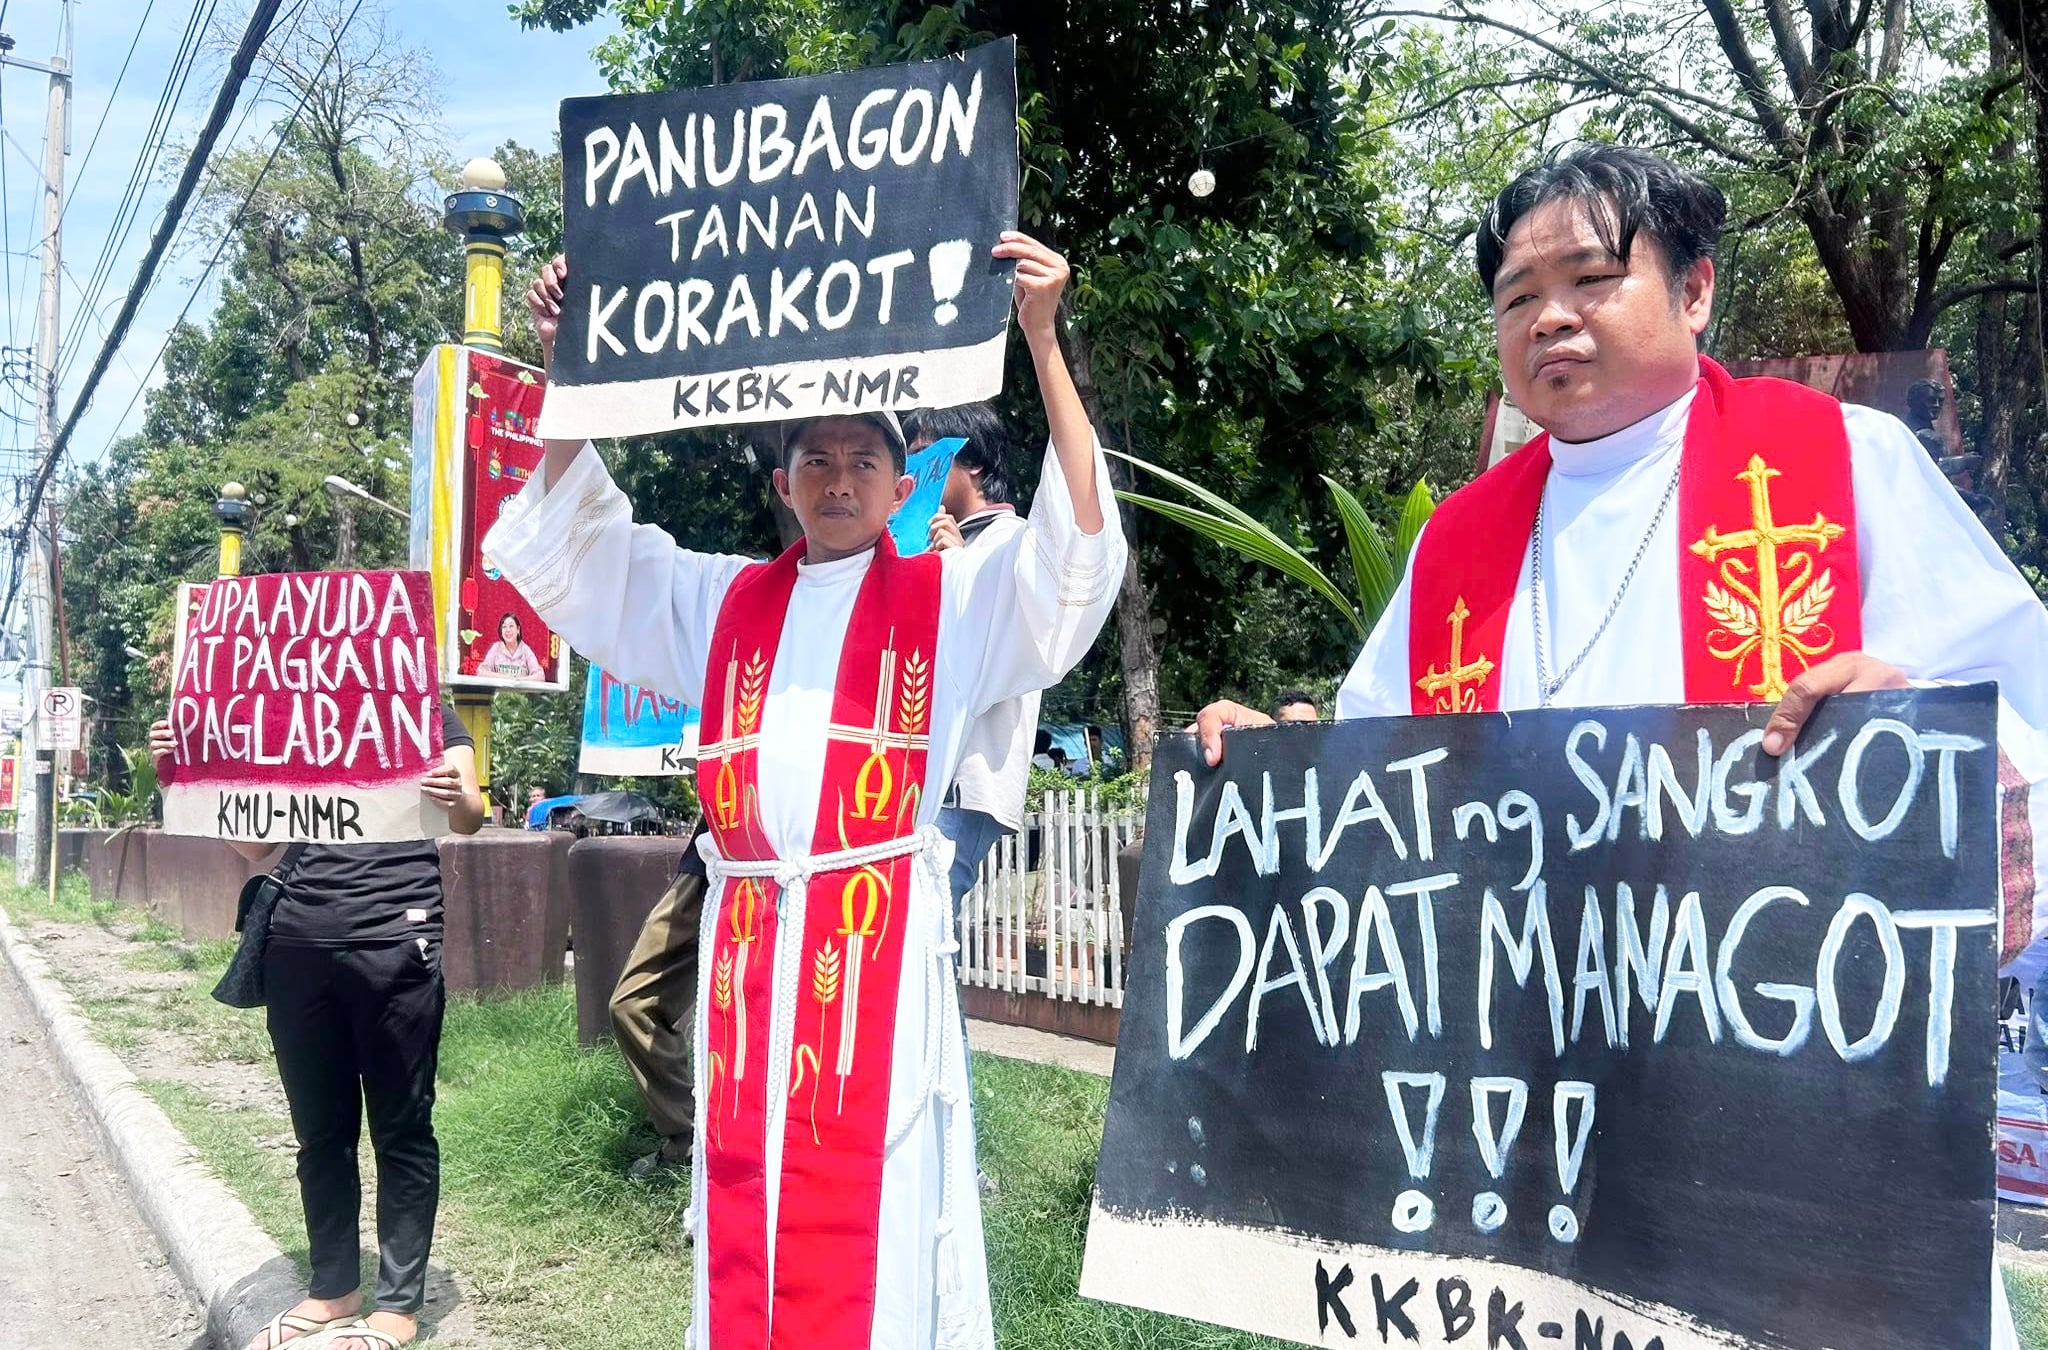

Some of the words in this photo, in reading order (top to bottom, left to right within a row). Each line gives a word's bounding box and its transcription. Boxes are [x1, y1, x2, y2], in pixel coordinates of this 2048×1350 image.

[584, 69, 983, 207] PANUBAGON
[655, 185, 876, 264] TANAN
[189, 579, 267, 638] UPA,
[269, 573, 418, 638] AYUDA
[178, 634, 224, 694] AT
[232, 633, 429, 694] PAGKAIN
[216, 790, 364, 841] KMU-NMR
[1168, 746, 1450, 885] LAHAT
[1452, 789, 1545, 892] ng
[1564, 717, 1988, 859] SANGKOT
[1165, 873, 1463, 1060] DAPAT
[1478, 879, 1998, 1088] MANAGOT
